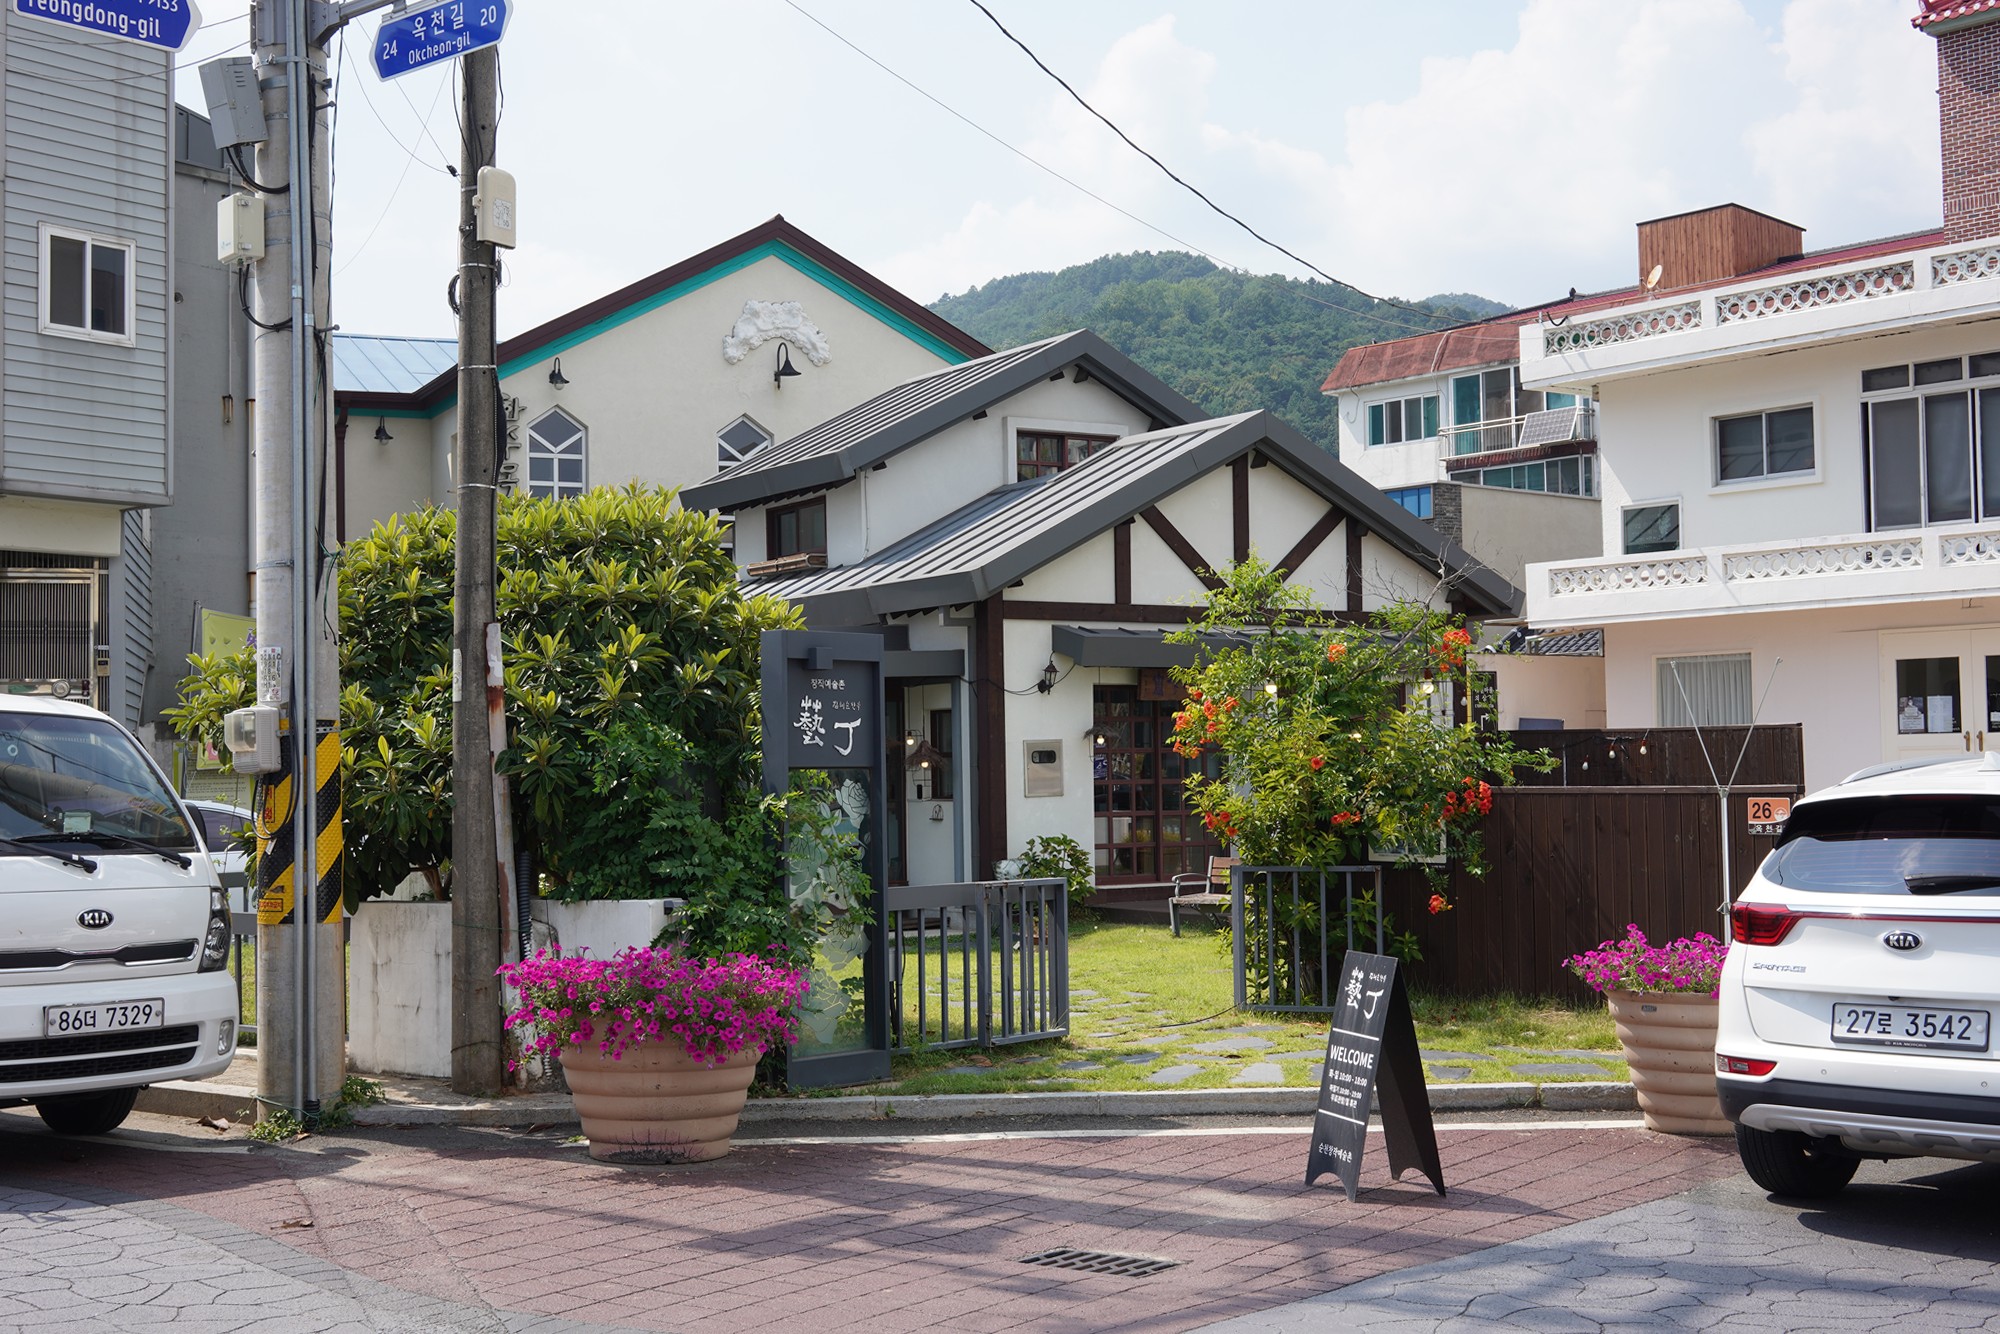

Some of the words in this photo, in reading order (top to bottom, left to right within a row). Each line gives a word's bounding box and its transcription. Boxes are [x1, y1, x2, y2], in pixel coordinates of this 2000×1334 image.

[383, 40, 398, 60] 24
[412, 2, 465, 41] 옥천길
[480, 5, 497, 27] 20
[408, 31, 471, 65] Okcheon-gil
[1752, 802, 1772, 819] 26
[84, 912, 110, 926] KIA
[1889, 935, 1916, 948] KIA
[58, 1010, 97, 1032] 86더
[106, 1004, 153, 1028] 7329
[1846, 1009, 1892, 1035] 27로
[1905, 1012, 1972, 1041] 3542
[1330, 1044, 1374, 1069] WELCOME
